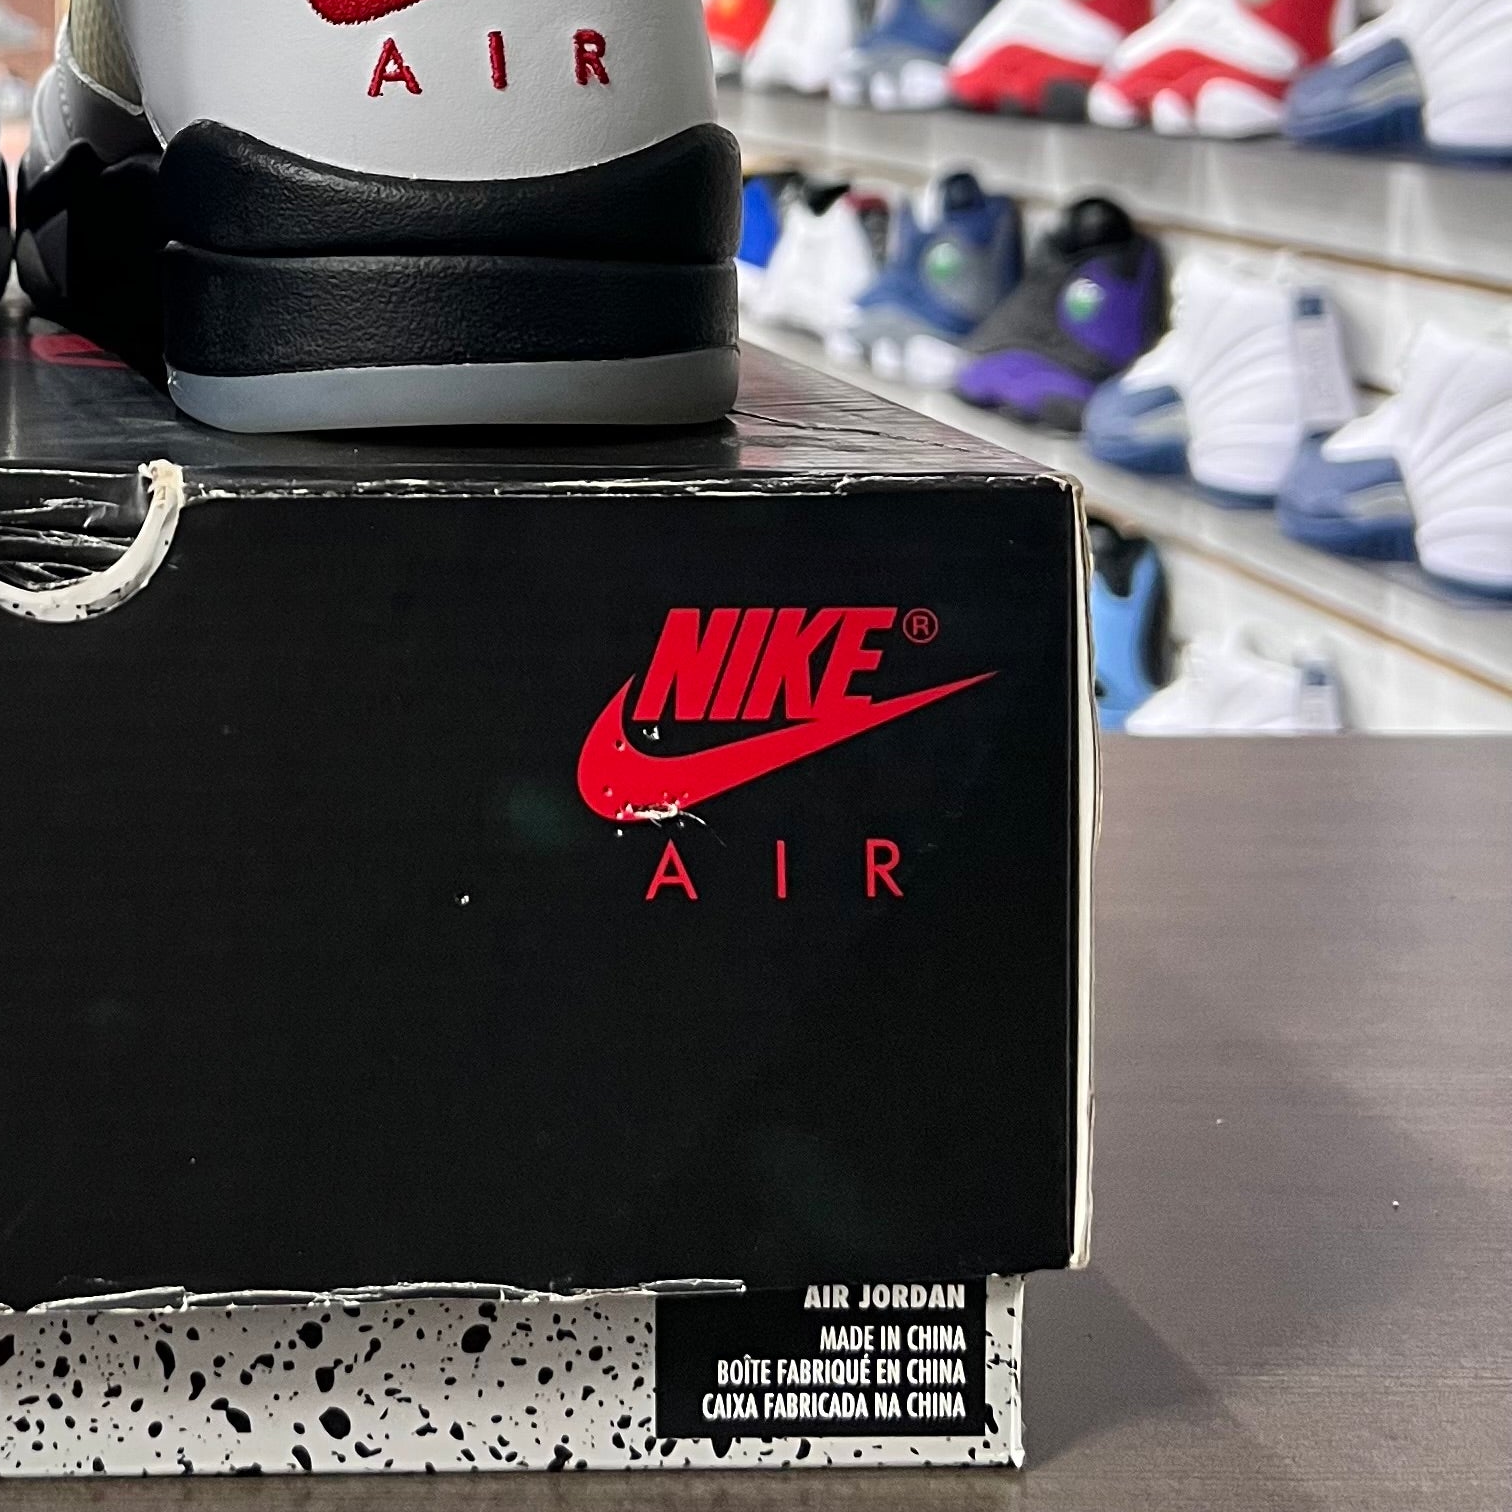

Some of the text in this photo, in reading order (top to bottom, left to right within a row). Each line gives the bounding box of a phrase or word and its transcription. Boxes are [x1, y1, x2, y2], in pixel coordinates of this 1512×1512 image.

[367, 28, 610, 97] AIR
[632, 607, 897, 721] NIKE
[645, 839, 904, 901] AIR
[803, 1284, 966, 1309] AIR JORDAN
[820, 1325, 967, 1351] MADE IN CHINA
[717, 1353, 967, 1386] BOÎTE FABRIQUÉ EN CHINA
[702, 1392, 967, 1419] CAIXA FABRICADA NA CHINA
